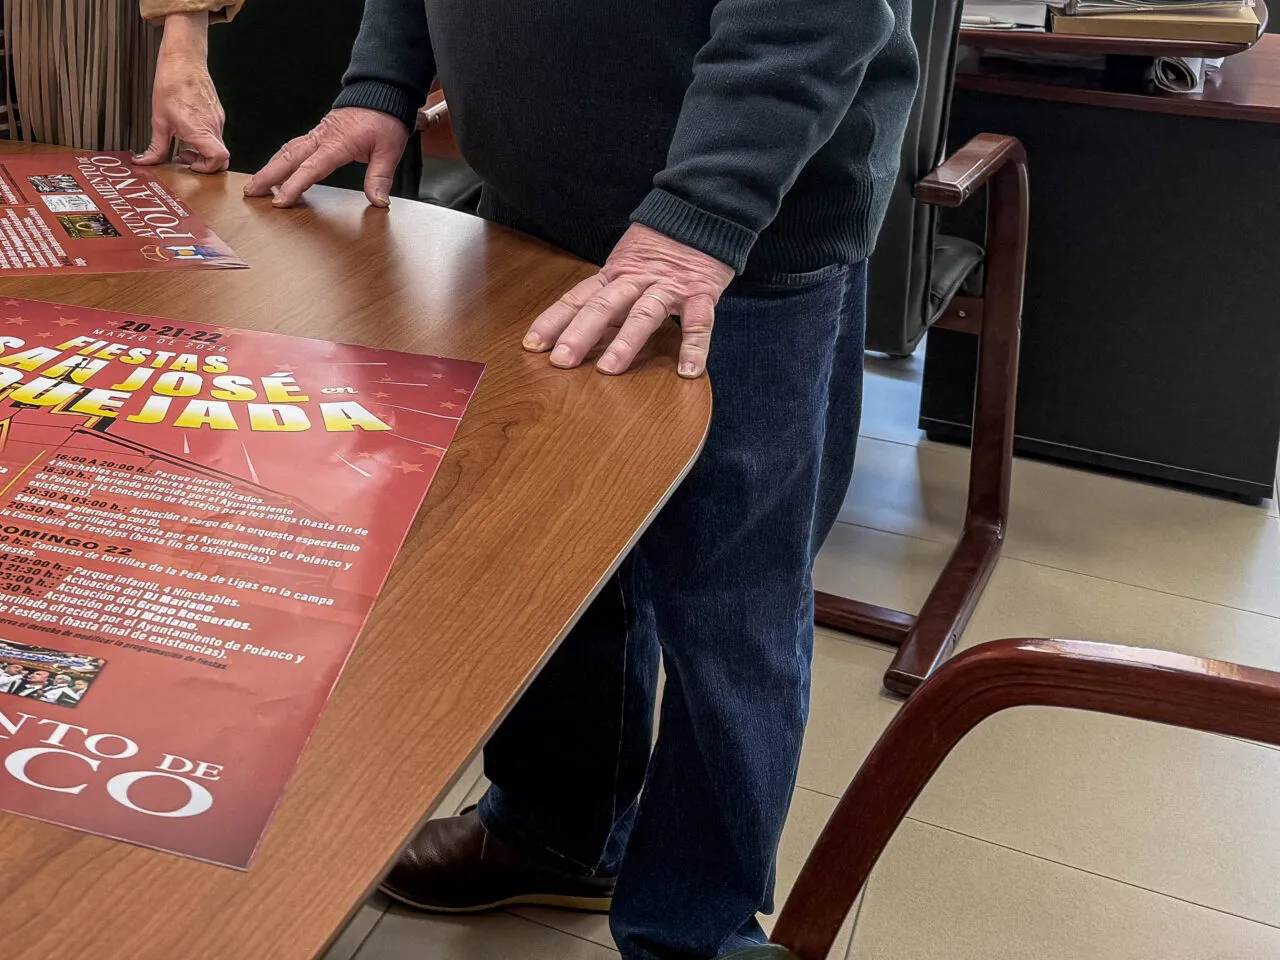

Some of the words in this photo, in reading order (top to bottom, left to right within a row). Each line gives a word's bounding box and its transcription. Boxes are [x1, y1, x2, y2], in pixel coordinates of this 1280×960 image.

[78, 164, 160, 239] AYUNTAMIENTO
[91, 156, 196, 240] POLANCO
[55, 335, 228, 373] FIESTAS
[92, 328, 146, 342] MARZO
[156, 338, 175, 346] DE
[184, 343, 228, 352] 2026
[117, 320, 222, 343] 20-21-22
[110, 366, 310, 403] JOSÉ
[320, 385, 359, 395] en
[54, 453, 88, 462] 16:00
[98, 460, 135, 471] 20:00
[153, 470, 191, 481] Parque
[10, 537, 32, 546] h.:
[30, 541, 84, 556] Consurso
[83, 551, 99, 559] de
[99, 554, 147, 568] tortillas
[147, 563, 164, 572] de
[164, 566, 178, 574] la
[178, 569, 208, 580] Peña
[209, 575, 225, 584] de
[226, 578, 259, 590] Ligas
[278, 588, 291, 597] la
[292, 592, 334, 605] campa
[102, 544, 133, 556] 22
[4, 563, 42, 576] 21:30
[41, 571, 63, 580] h.:
[61, 575, 124, 593] Actuación
[120, 587, 146, 597] del
[141, 591, 162, 601] DJ
[157, 594, 214, 612] Mariano.
[9, 555, 51, 568] 20:00
[50, 563, 72, 572] h.:
[70, 567, 116, 581] Parque
[112, 575, 159, 590] infantil.
[170, 587, 239, 606] Hinchables.
[21, 587, 43, 597] h.:
[42, 591, 106, 610] Actuación
[102, 603, 128, 614] del
[122, 608, 144, 618] DJ
[139, 611, 197, 629] Mariano.
[33, 579, 55, 589] h.:
[54, 584, 118, 602] Actuación
[113, 596, 139, 606] del
[134, 600, 179, 615] Grupo
[175, 608, 250, 630] Recuerdos.
[7, 606, 59, 622] Festejos
[56, 616, 99, 631] (hasta
[98, 624, 131, 637] final
[129, 631, 147, 641] de
[145, 635, 226, 659] existencias).
[47, 604, 101, 620] ofrecida
[95, 615, 122, 625] por
[119, 619, 139, 628] el
[134, 621, 223, 646] Ayuntamiento
[223, 640, 242, 650] de
[242, 643, 294, 661] Polanco
[293, 656, 304, 665] y
[155, 753, 224, 781] DE
